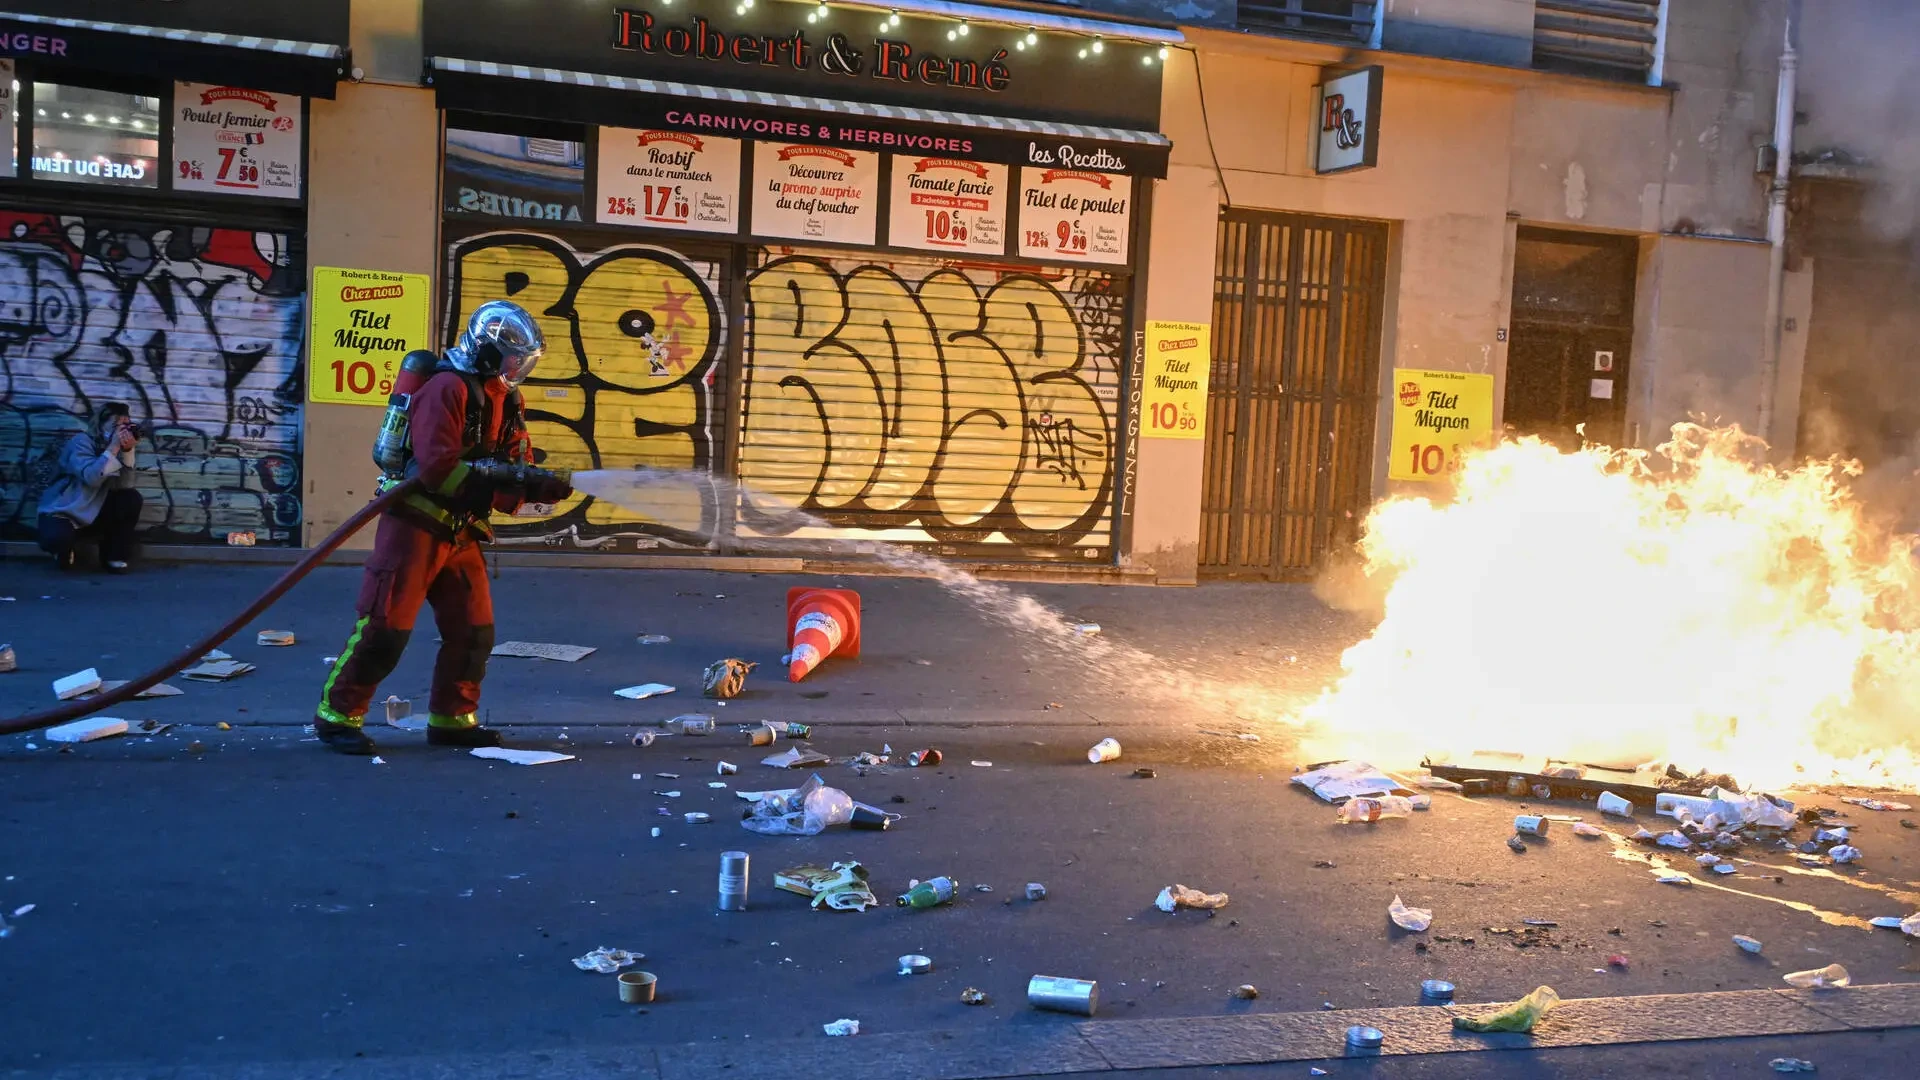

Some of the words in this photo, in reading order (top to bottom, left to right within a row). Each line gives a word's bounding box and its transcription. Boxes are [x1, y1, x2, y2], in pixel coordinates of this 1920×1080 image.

[612, 6, 812, 70] Robert
[820, 32, 864, 76] &
[873, 38, 1012, 92] René
[182, 108, 222, 124] Poulet
[222, 112, 270, 128] fermier
[665, 111, 812, 138] CARNIVORES
[818, 126, 831, 140] &
[839, 129, 973, 153] HERBIVORES
[648, 148, 696, 171] Rosbif
[788, 148, 802, 156] TOUS
[1029, 142, 1054, 163] les
[1058, 145, 1126, 170] Recettes
[180, 160, 190, 178] 9
[217, 148, 236, 180] 7
[240, 147, 248, 158] €
[788, 164, 844, 181] Découvrez
[239, 166, 258, 182] 50
[626, 165, 653, 176] dans
[654, 168, 664, 178] le
[666, 170, 712, 182] rumsteck
[768, 179, 780, 192] la
[782, 182, 817, 196] promo
[820, 186, 862, 200] surprise
[908, 174, 956, 192] Tomate
[954, 179, 994, 196] farcie
[608, 197, 626, 215] 25
[644, 185, 672, 216] 17
[674, 186, 682, 196] €
[776, 196, 791, 208] du
[794, 198, 816, 214] chef
[818, 199, 859, 214] boucher
[1025, 188, 1057, 208] Filet
[1060, 194, 1078, 210] de
[1080, 198, 1126, 216] poulet
[674, 202, 689, 218] 10
[926, 210, 950, 240] 10
[952, 210, 959, 219] €
[952, 226, 968, 240] 90
[1056, 220, 1070, 248] 9
[1074, 220, 1080, 228] €
[1026, 230, 1040, 247] 12
[1072, 235, 1086, 250] 90
[341, 270, 371, 280] Robert
[381, 274, 404, 282] René
[342, 286, 371, 300] Chez
[373, 286, 402, 298] nous
[350, 309, 391, 330] Filet
[334, 329, 406, 355] Mignon
[1160, 340, 1178, 351] Chez
[1179, 338, 1197, 348] nous
[1165, 360, 1190, 373] Filet
[331, 360, 376, 394] 10
[384, 361, 392, 371] €
[1155, 374, 1198, 392] Mignon
[380, 380, 394, 395] 9
[1427, 391, 1458, 409] Filet
[1150, 402, 1178, 430] 10
[1182, 402, 1188, 410] €
[1180, 418, 1196, 430] 90
[1415, 410, 1470, 433] Mignon
[1410, 444, 1444, 475] 10
